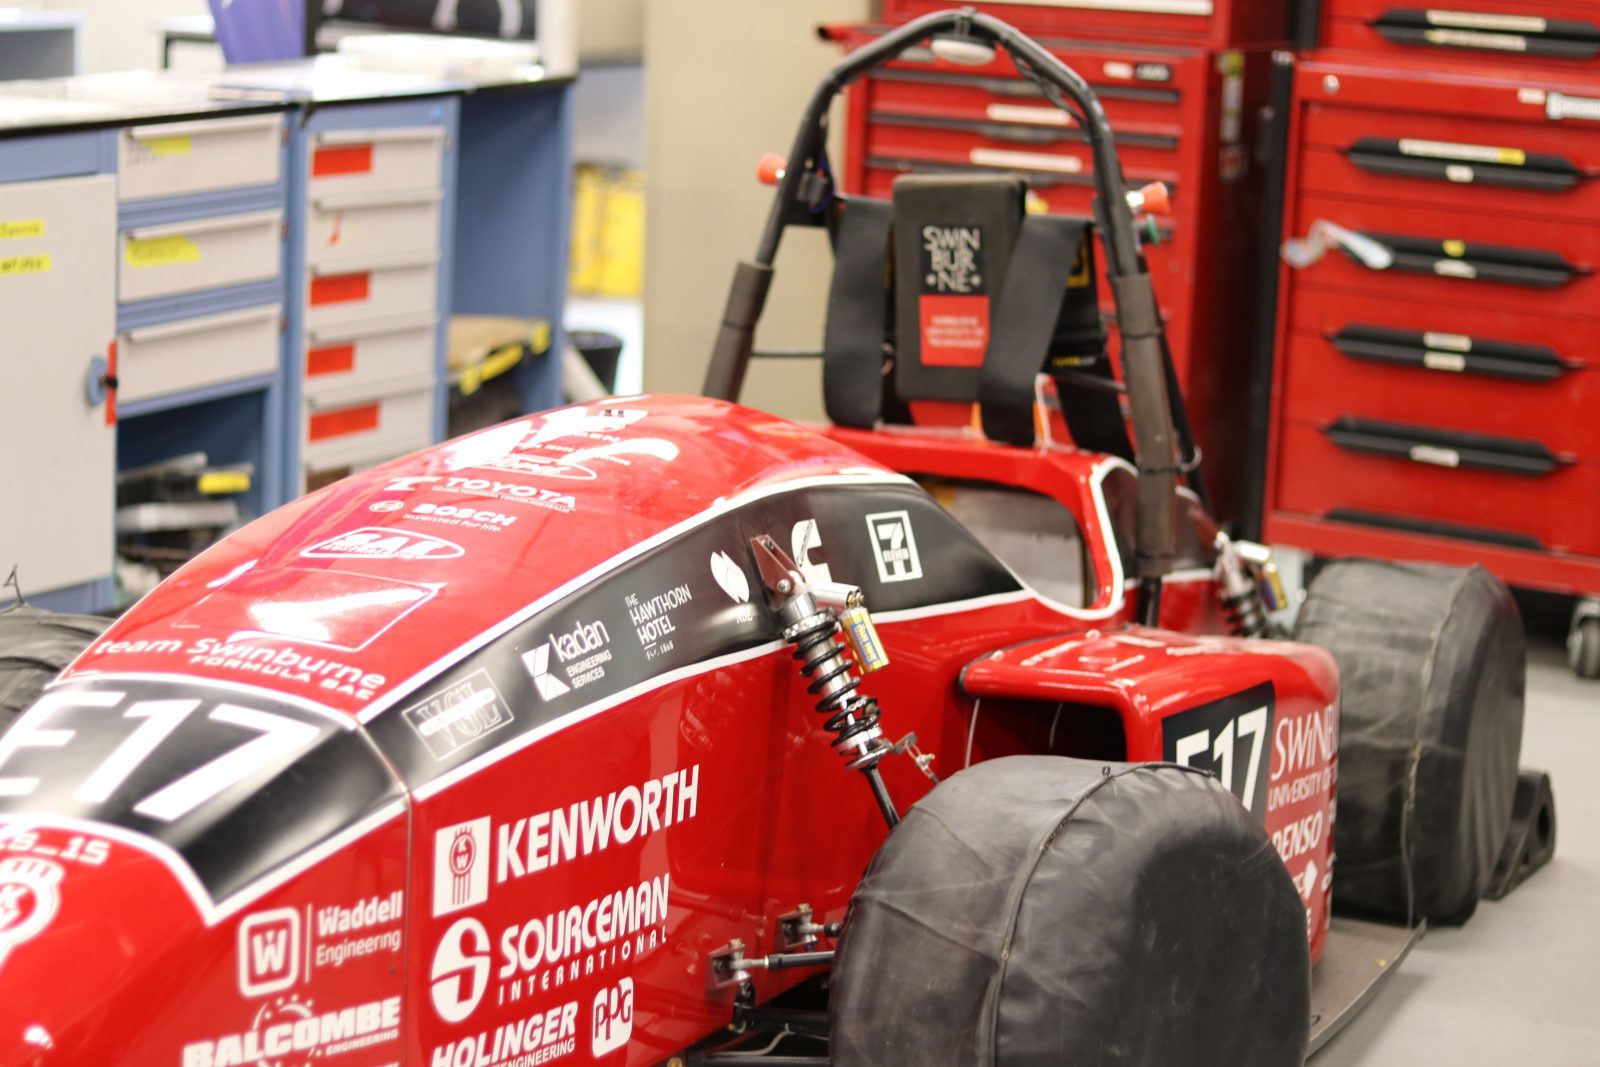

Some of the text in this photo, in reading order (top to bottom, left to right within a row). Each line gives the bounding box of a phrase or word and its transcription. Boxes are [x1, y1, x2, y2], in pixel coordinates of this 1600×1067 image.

[923, 225, 980, 250] SWIN
[931, 249, 976, 273] BUR
[447, 477, 577, 508] TOYOTA
[412, 503, 517, 526] BOSCH
[461, 520, 481, 529] for
[481, 523, 502, 533] life
[625, 592, 640, 608] THE
[629, 583, 693, 627] HAWTHORN
[549, 620, 610, 663] kadan
[636, 614, 676, 645] HOTEL
[95, 637, 387, 690] team Swinburne
[189, 654, 375, 700] FORMULA SAE
[566, 649, 613, 679] ENGINEERING
[571, 665, 606, 689] SERVICES
[1267, 771, 1321, 812] UNIVERSITY
[496, 764, 700, 884] KENWORTH
[317, 889, 404, 938] Waddell
[500, 872, 670, 979] SOURCEMAN
[315, 930, 402, 967] Engineering
[499, 925, 668, 1006] INTERNATIONAL
[182, 996, 401, 1067] BALCOMBE
[432, 1001, 580, 1067] HOLINGER
[593, 987, 633, 1042] PPG
[326, 1027, 400, 1056] ENGINEERING
